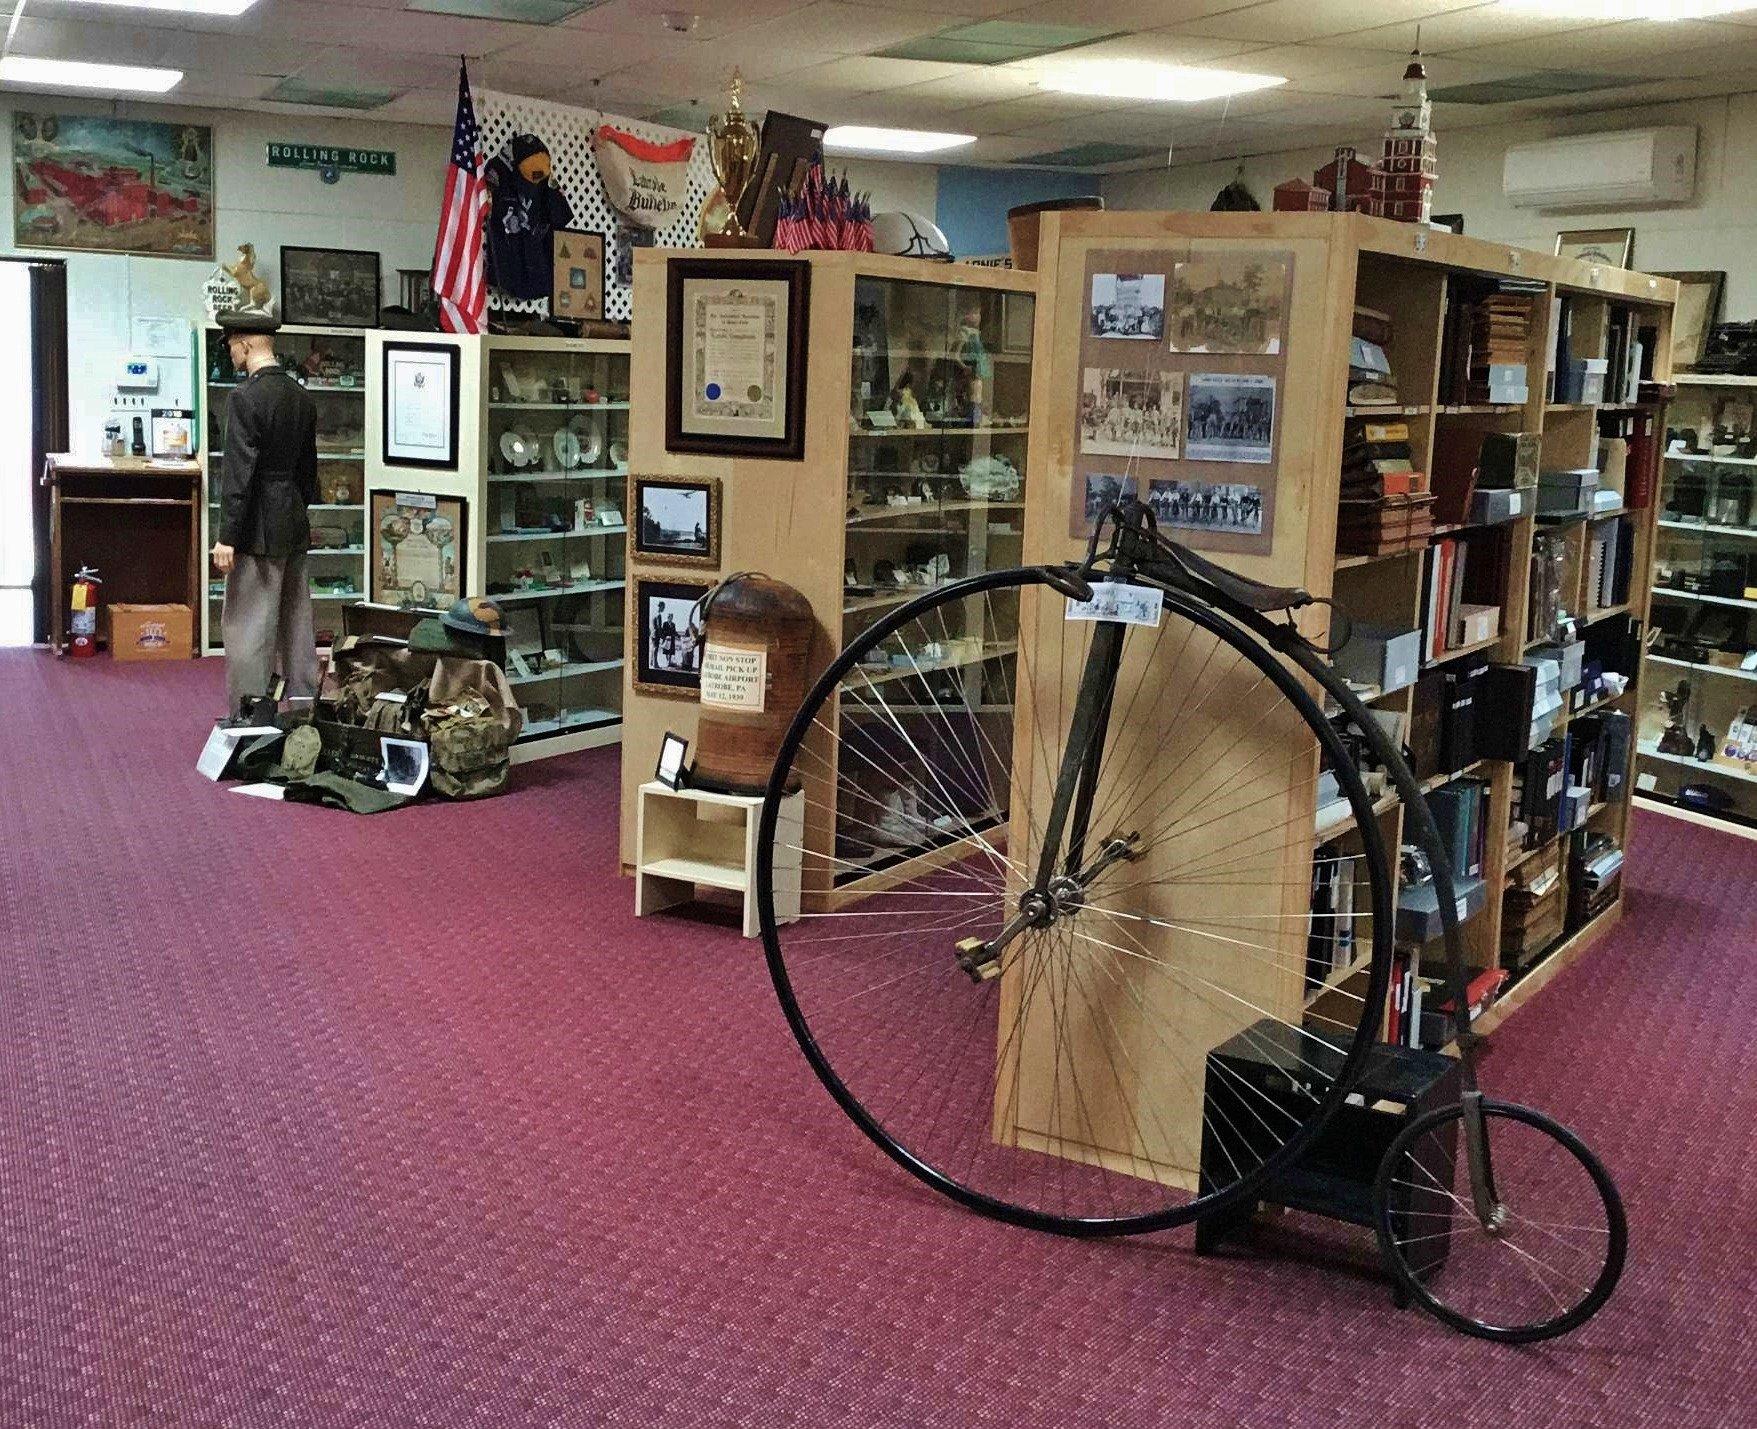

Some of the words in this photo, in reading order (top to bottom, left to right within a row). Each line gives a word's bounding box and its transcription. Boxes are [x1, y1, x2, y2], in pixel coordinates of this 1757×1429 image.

[271, 145, 339, 161] ROLLING
[349, 151, 388, 166] ROCK
[207, 285, 239, 296] ROLLING
[212, 295, 232, 303] ROCK
